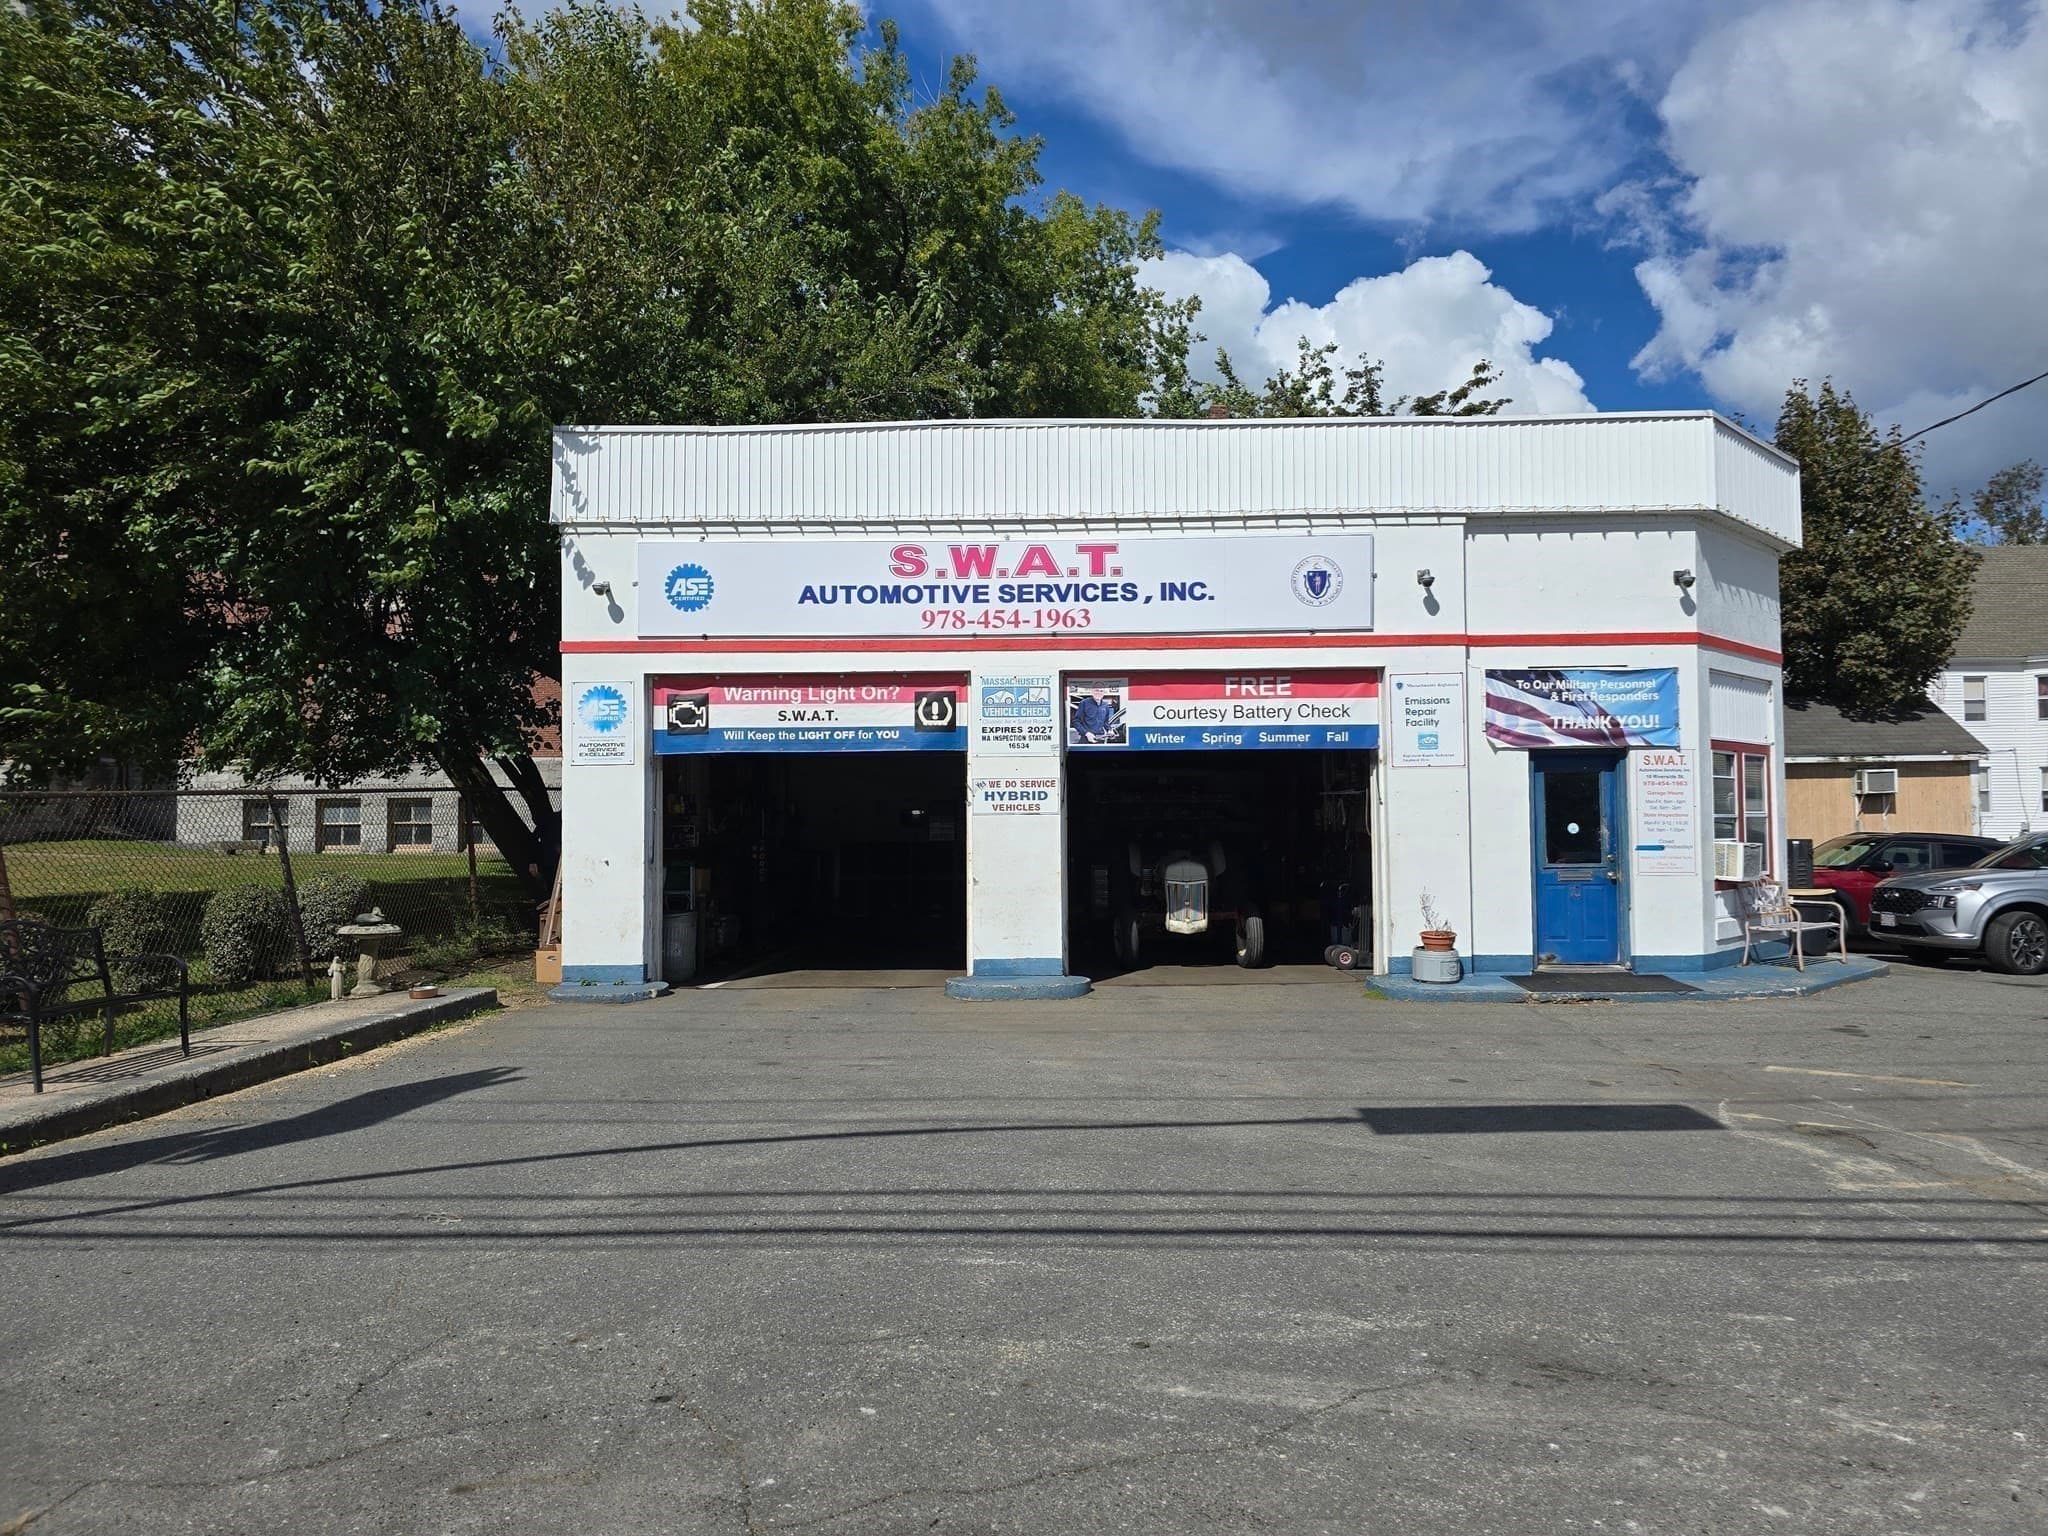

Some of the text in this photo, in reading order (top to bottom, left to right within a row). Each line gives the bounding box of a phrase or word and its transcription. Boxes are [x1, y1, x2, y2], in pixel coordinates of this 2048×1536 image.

[889, 543, 1123, 579] S.W.A.T.
[671, 578, 708, 596] ASE
[798, 584, 990, 604] AUTOMOTIVE
[1160, 581, 1215, 601] INC.
[921, 608, 1092, 629] 978-454-1963
[981, 677, 1050, 685] MASSACHUSETTS
[1225, 676, 1292, 696] FREE
[1516, 679, 1656, 691] To Our Military Personnel
[724, 685, 900, 704] Warning Light On?
[1551, 691, 1659, 704] & First Responders
[1405, 697, 1451, 705] Emissions
[777, 710, 839, 722] S.W.A.T.
[984, 708, 1049, 717] VEHICLE CHECK
[1153, 703, 1351, 722] Courtesy Battery Check
[1405, 708, 1437, 716] Repair
[1405, 718, 1440, 727] Facility
[1552, 715, 1659, 729] THANK YOU!
[724, 730, 899, 742] Will Keep the LIGHT OFF for YOU
[1145, 731, 1349, 745] Winter Spring Summer Fall
[1643, 755, 1686, 766] S.W.A.T.
[1005, 780, 1017, 788] DO
[1020, 780, 1056, 788] SERVICE
[984, 791, 1048, 801] HYBRID
